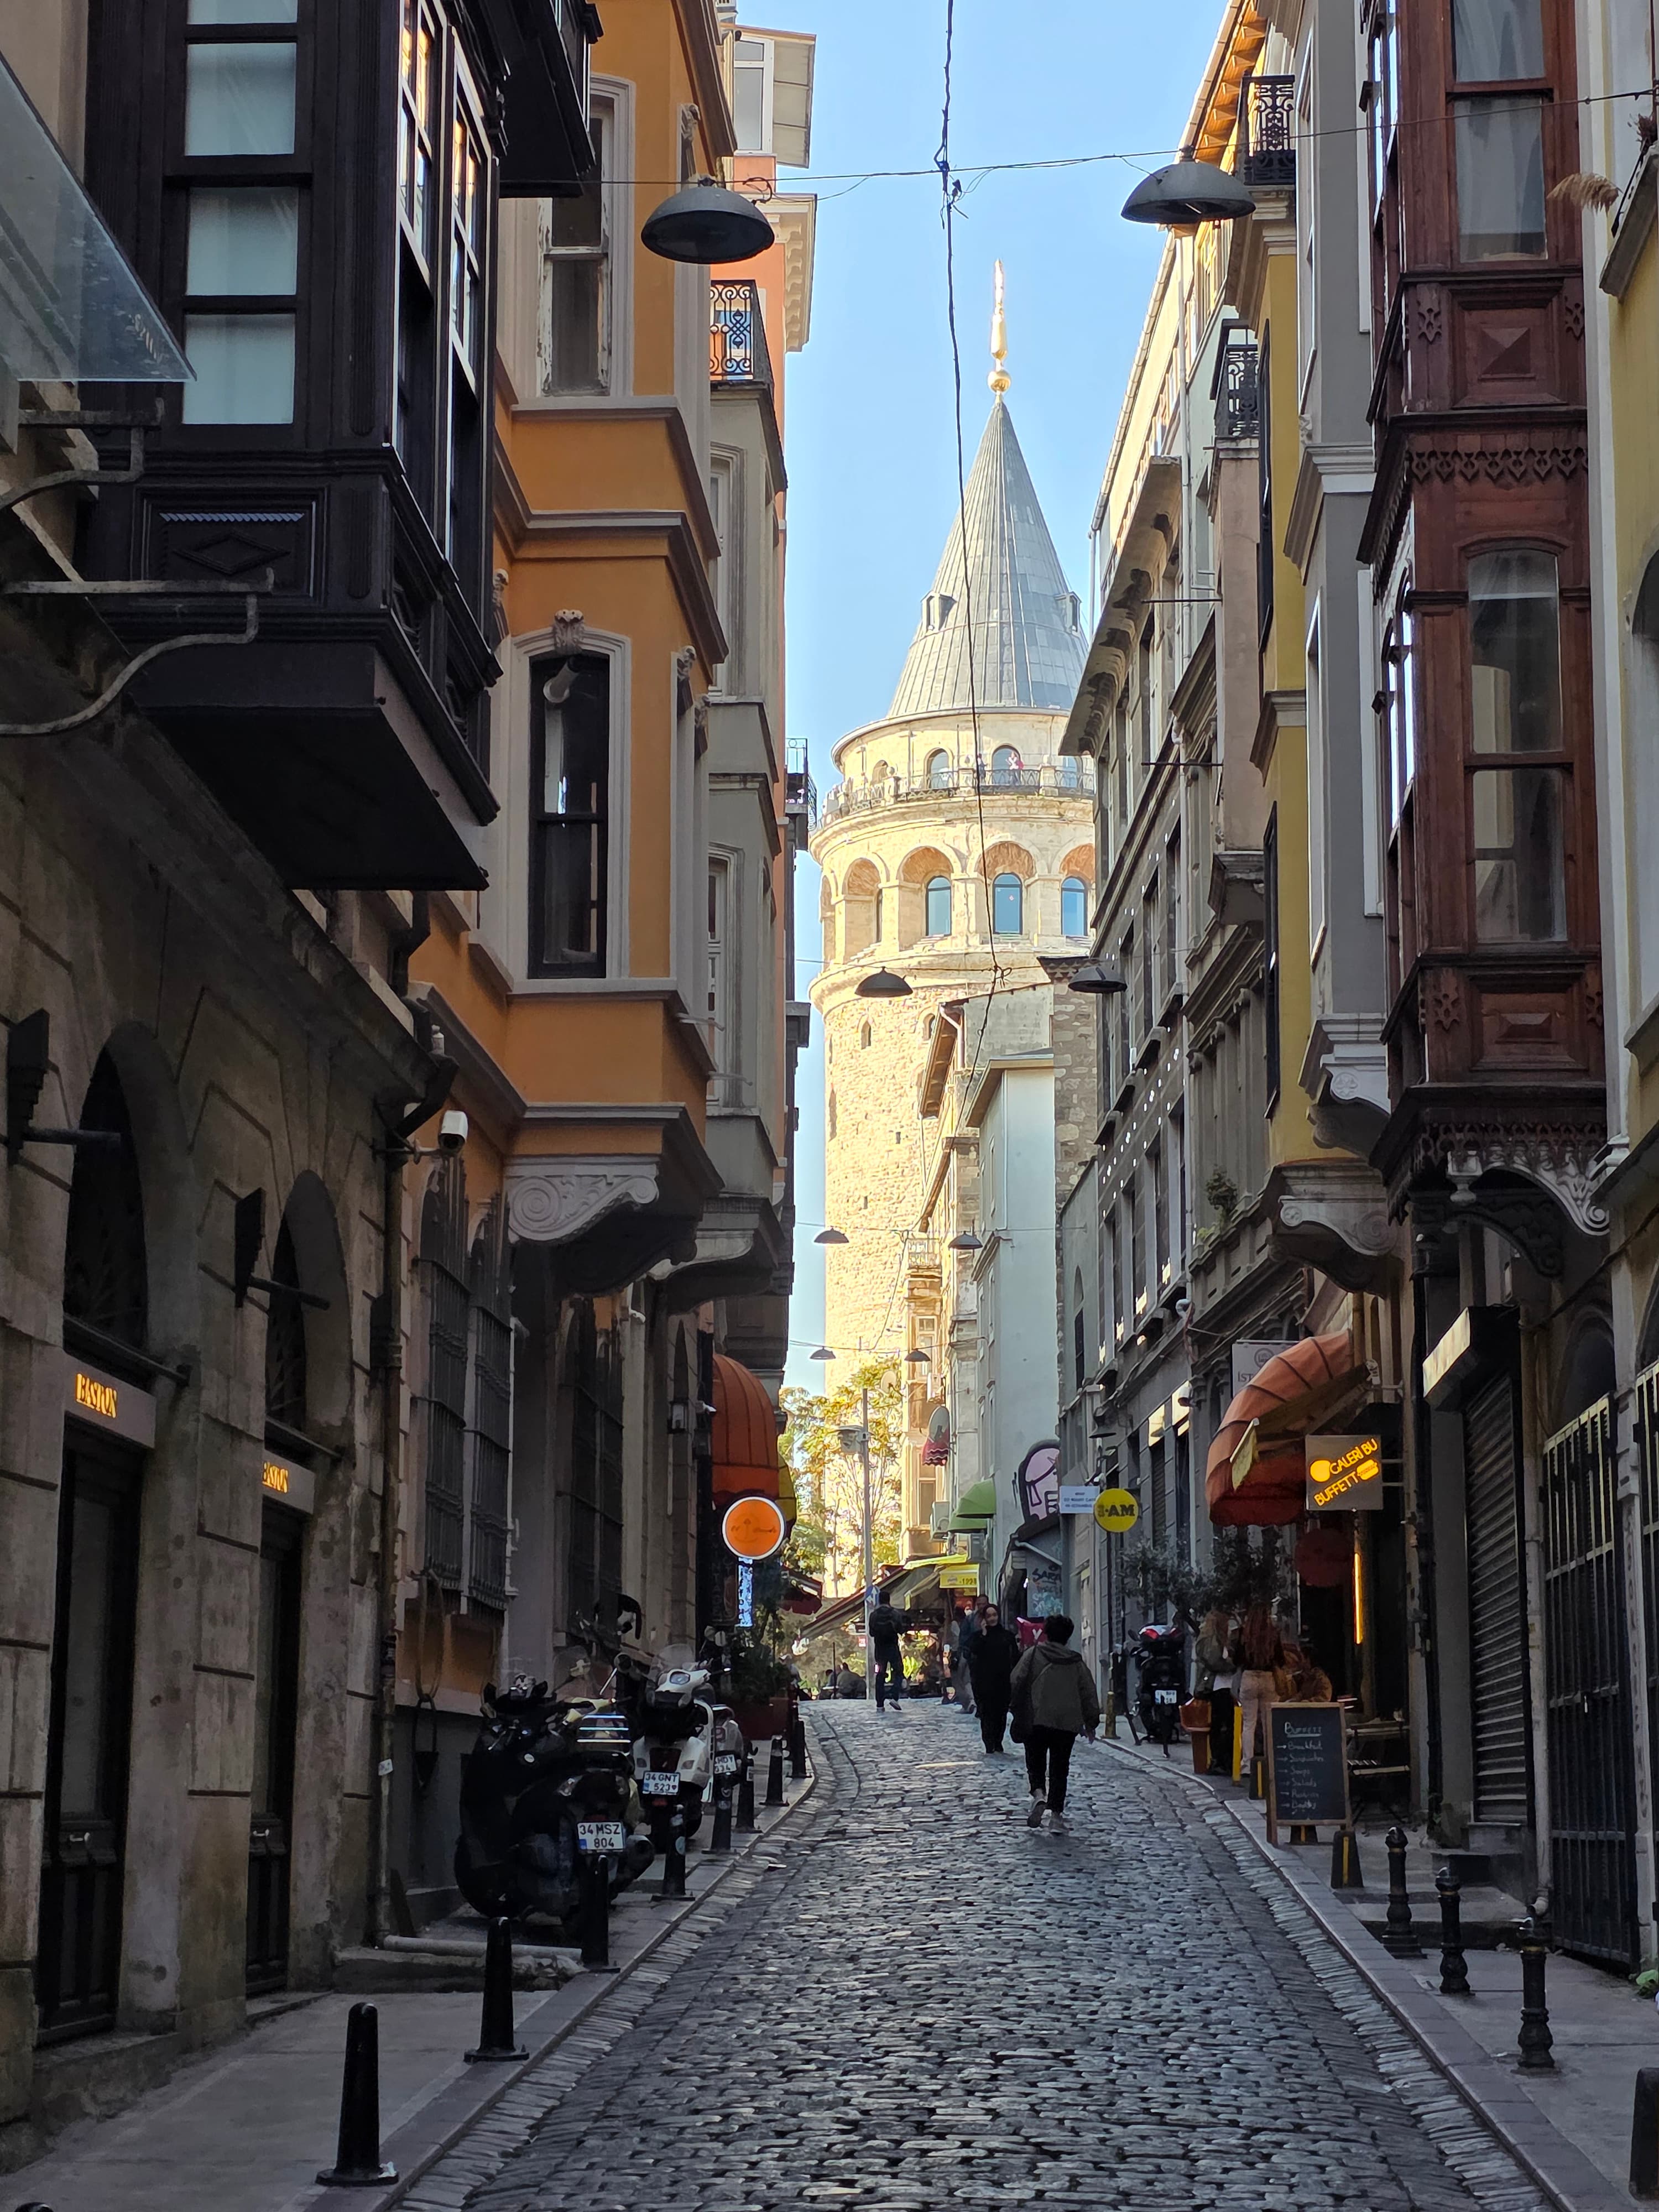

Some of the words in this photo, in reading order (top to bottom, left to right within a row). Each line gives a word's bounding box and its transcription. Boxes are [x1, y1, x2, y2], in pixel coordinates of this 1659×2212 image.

[1313, 1471, 1359, 1506] BUFFETT
[658, 1774, 677, 1782] GNT
[580, 1824, 594, 1835] 34
[596, 1824, 620, 1835] MSZ
[594, 1837, 614, 1848] 804
